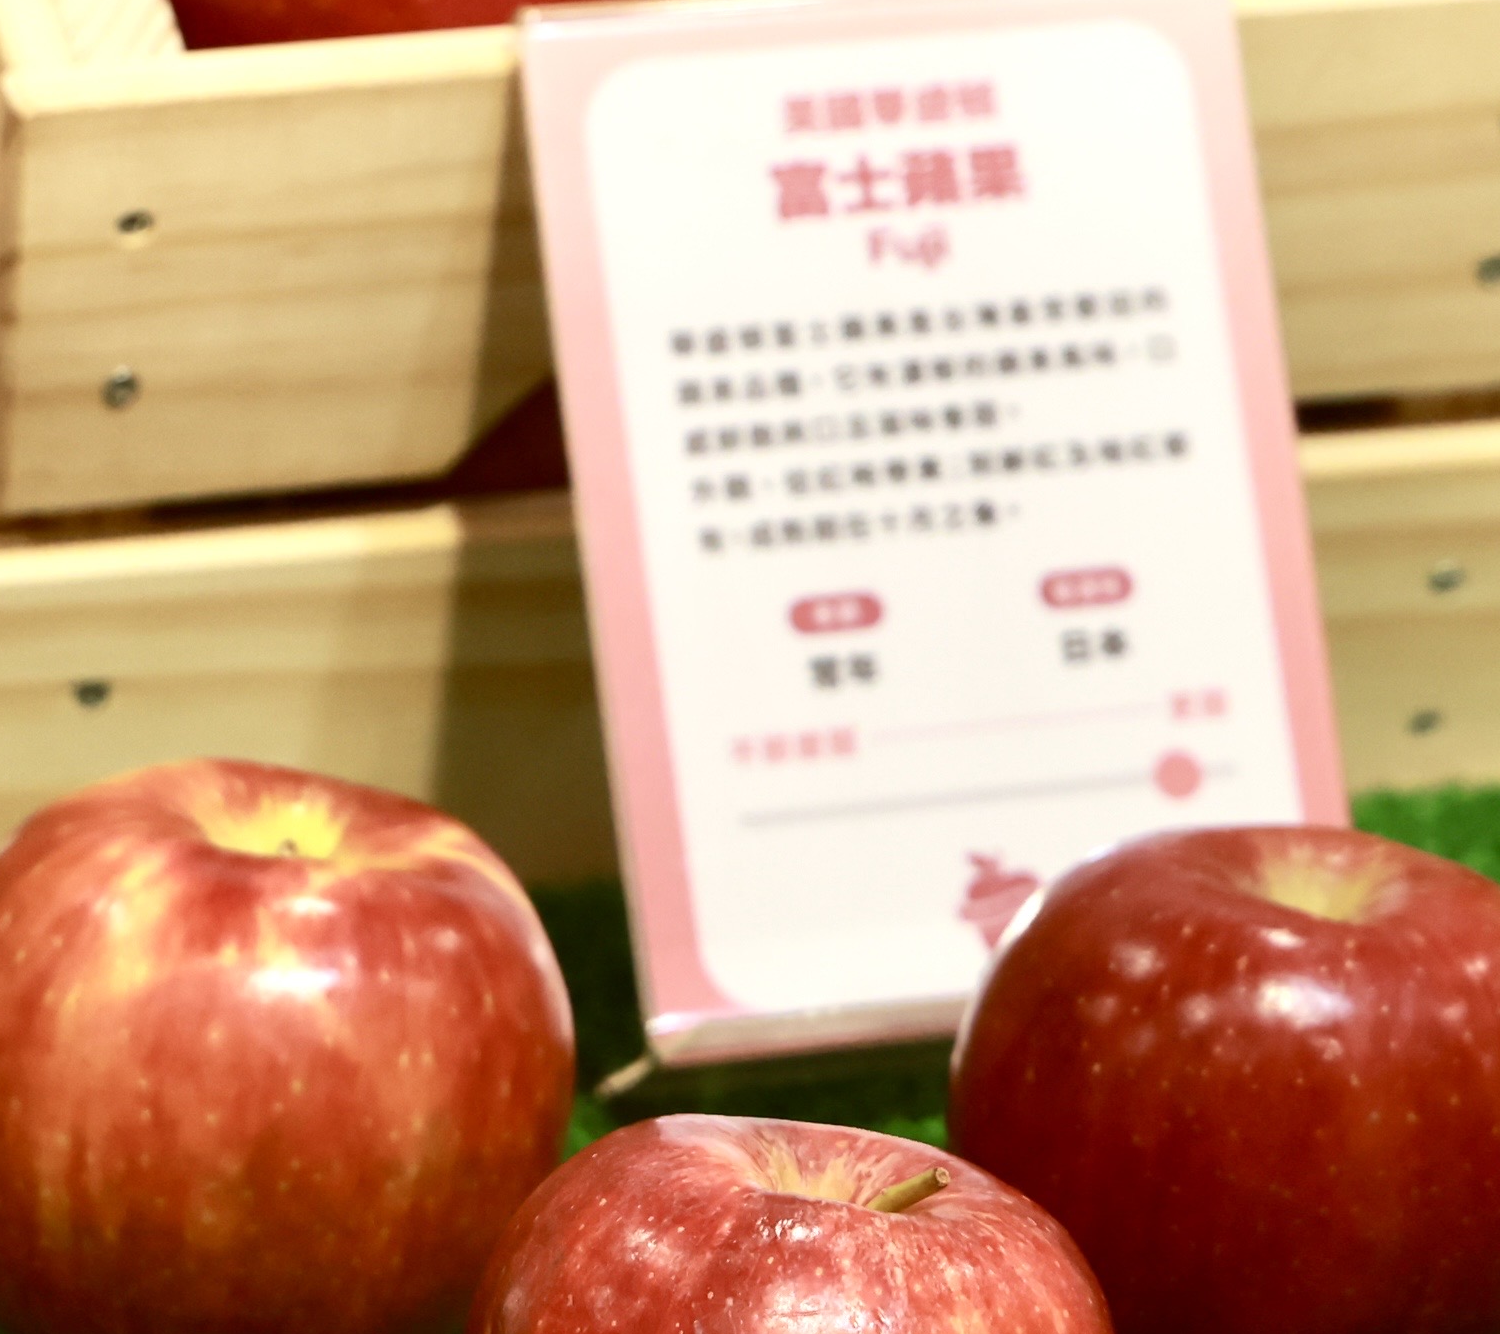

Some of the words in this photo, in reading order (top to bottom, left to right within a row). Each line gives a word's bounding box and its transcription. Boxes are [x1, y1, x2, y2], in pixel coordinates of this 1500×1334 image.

[771, 145, 1022, 220] 富士蘋果
[866, 226, 949, 270] Fuji
